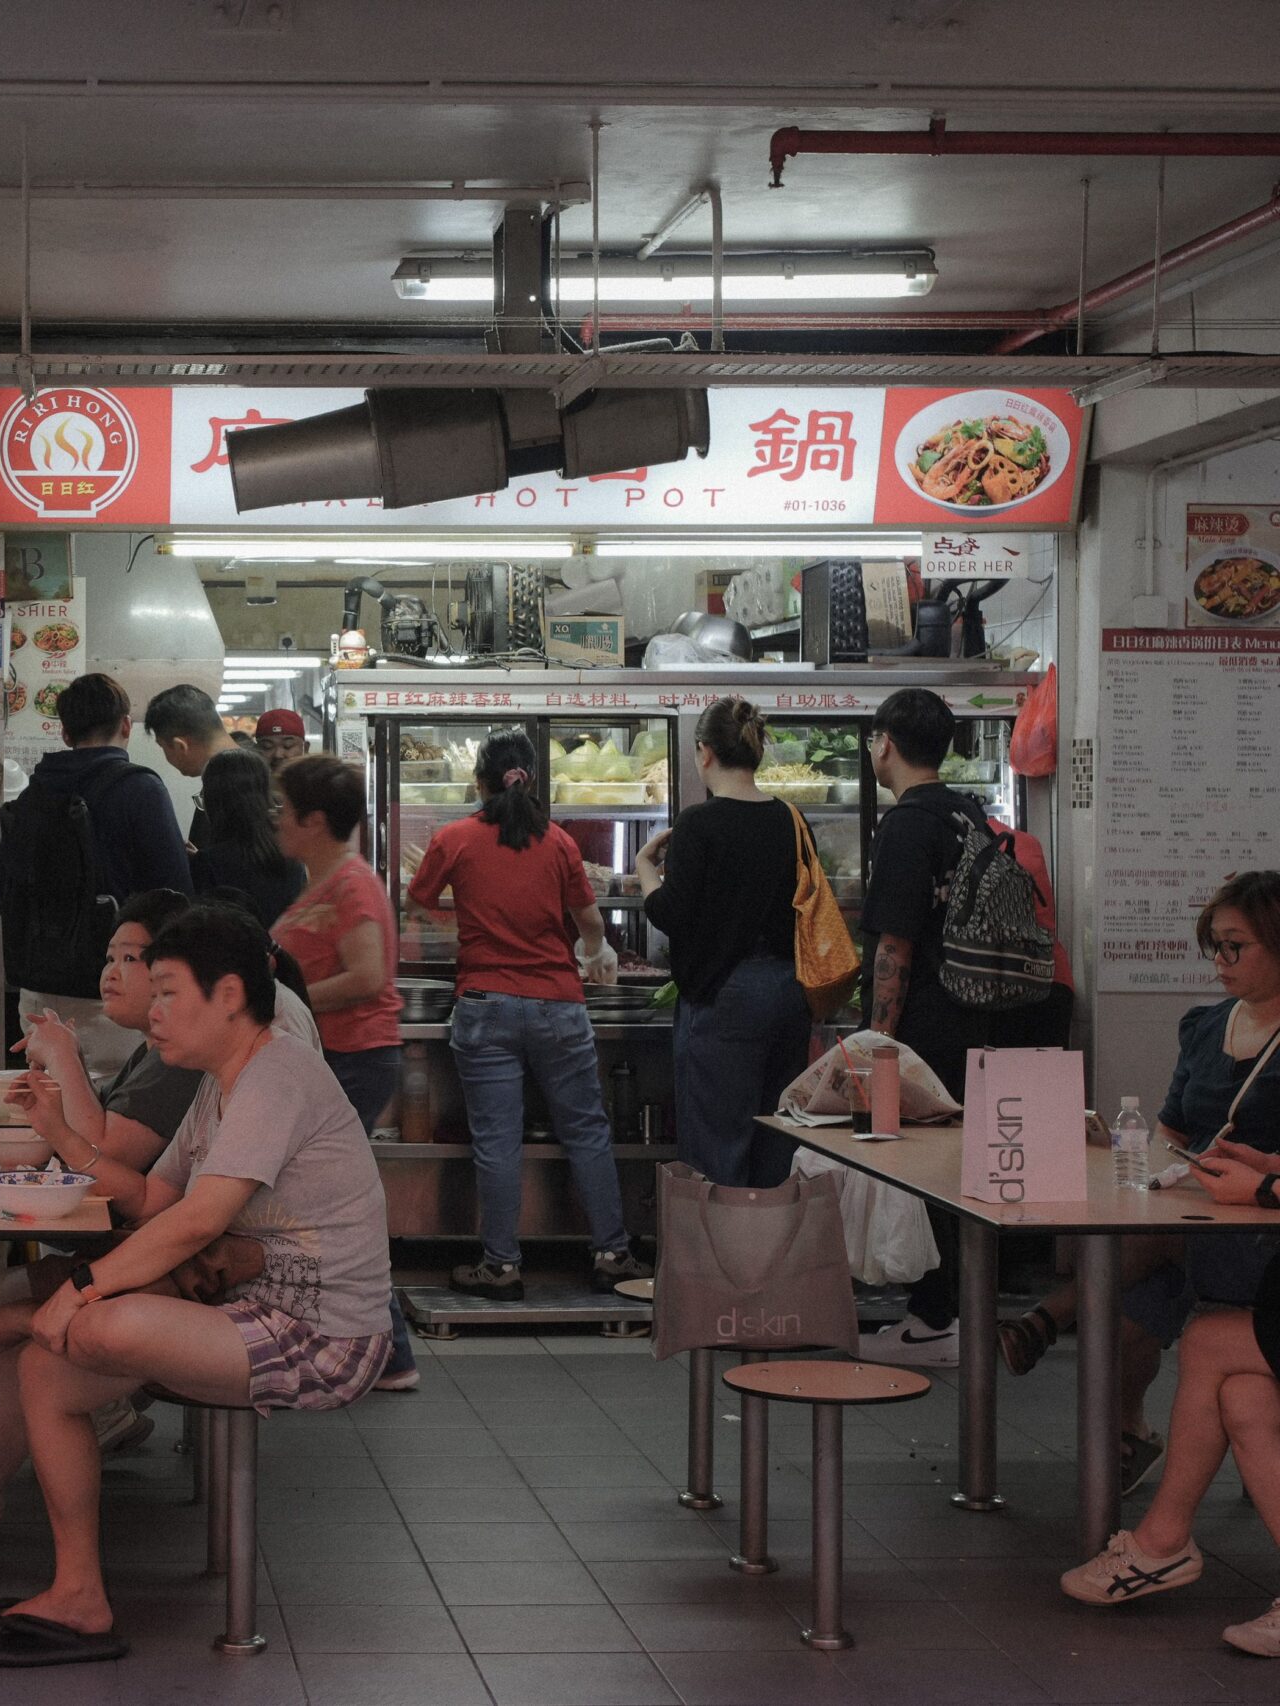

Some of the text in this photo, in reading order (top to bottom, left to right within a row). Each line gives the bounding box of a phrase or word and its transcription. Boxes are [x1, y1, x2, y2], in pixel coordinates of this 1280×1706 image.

[67, 394, 123, 446] HONG
[41, 481, 96, 496] 日日红
[475, 488, 726, 508] HOT POT
[783, 500, 847, 512] #01-1036
[926, 561, 1013, 572] ORDER HER
[1103, 951, 1185, 962] Operating Hours
